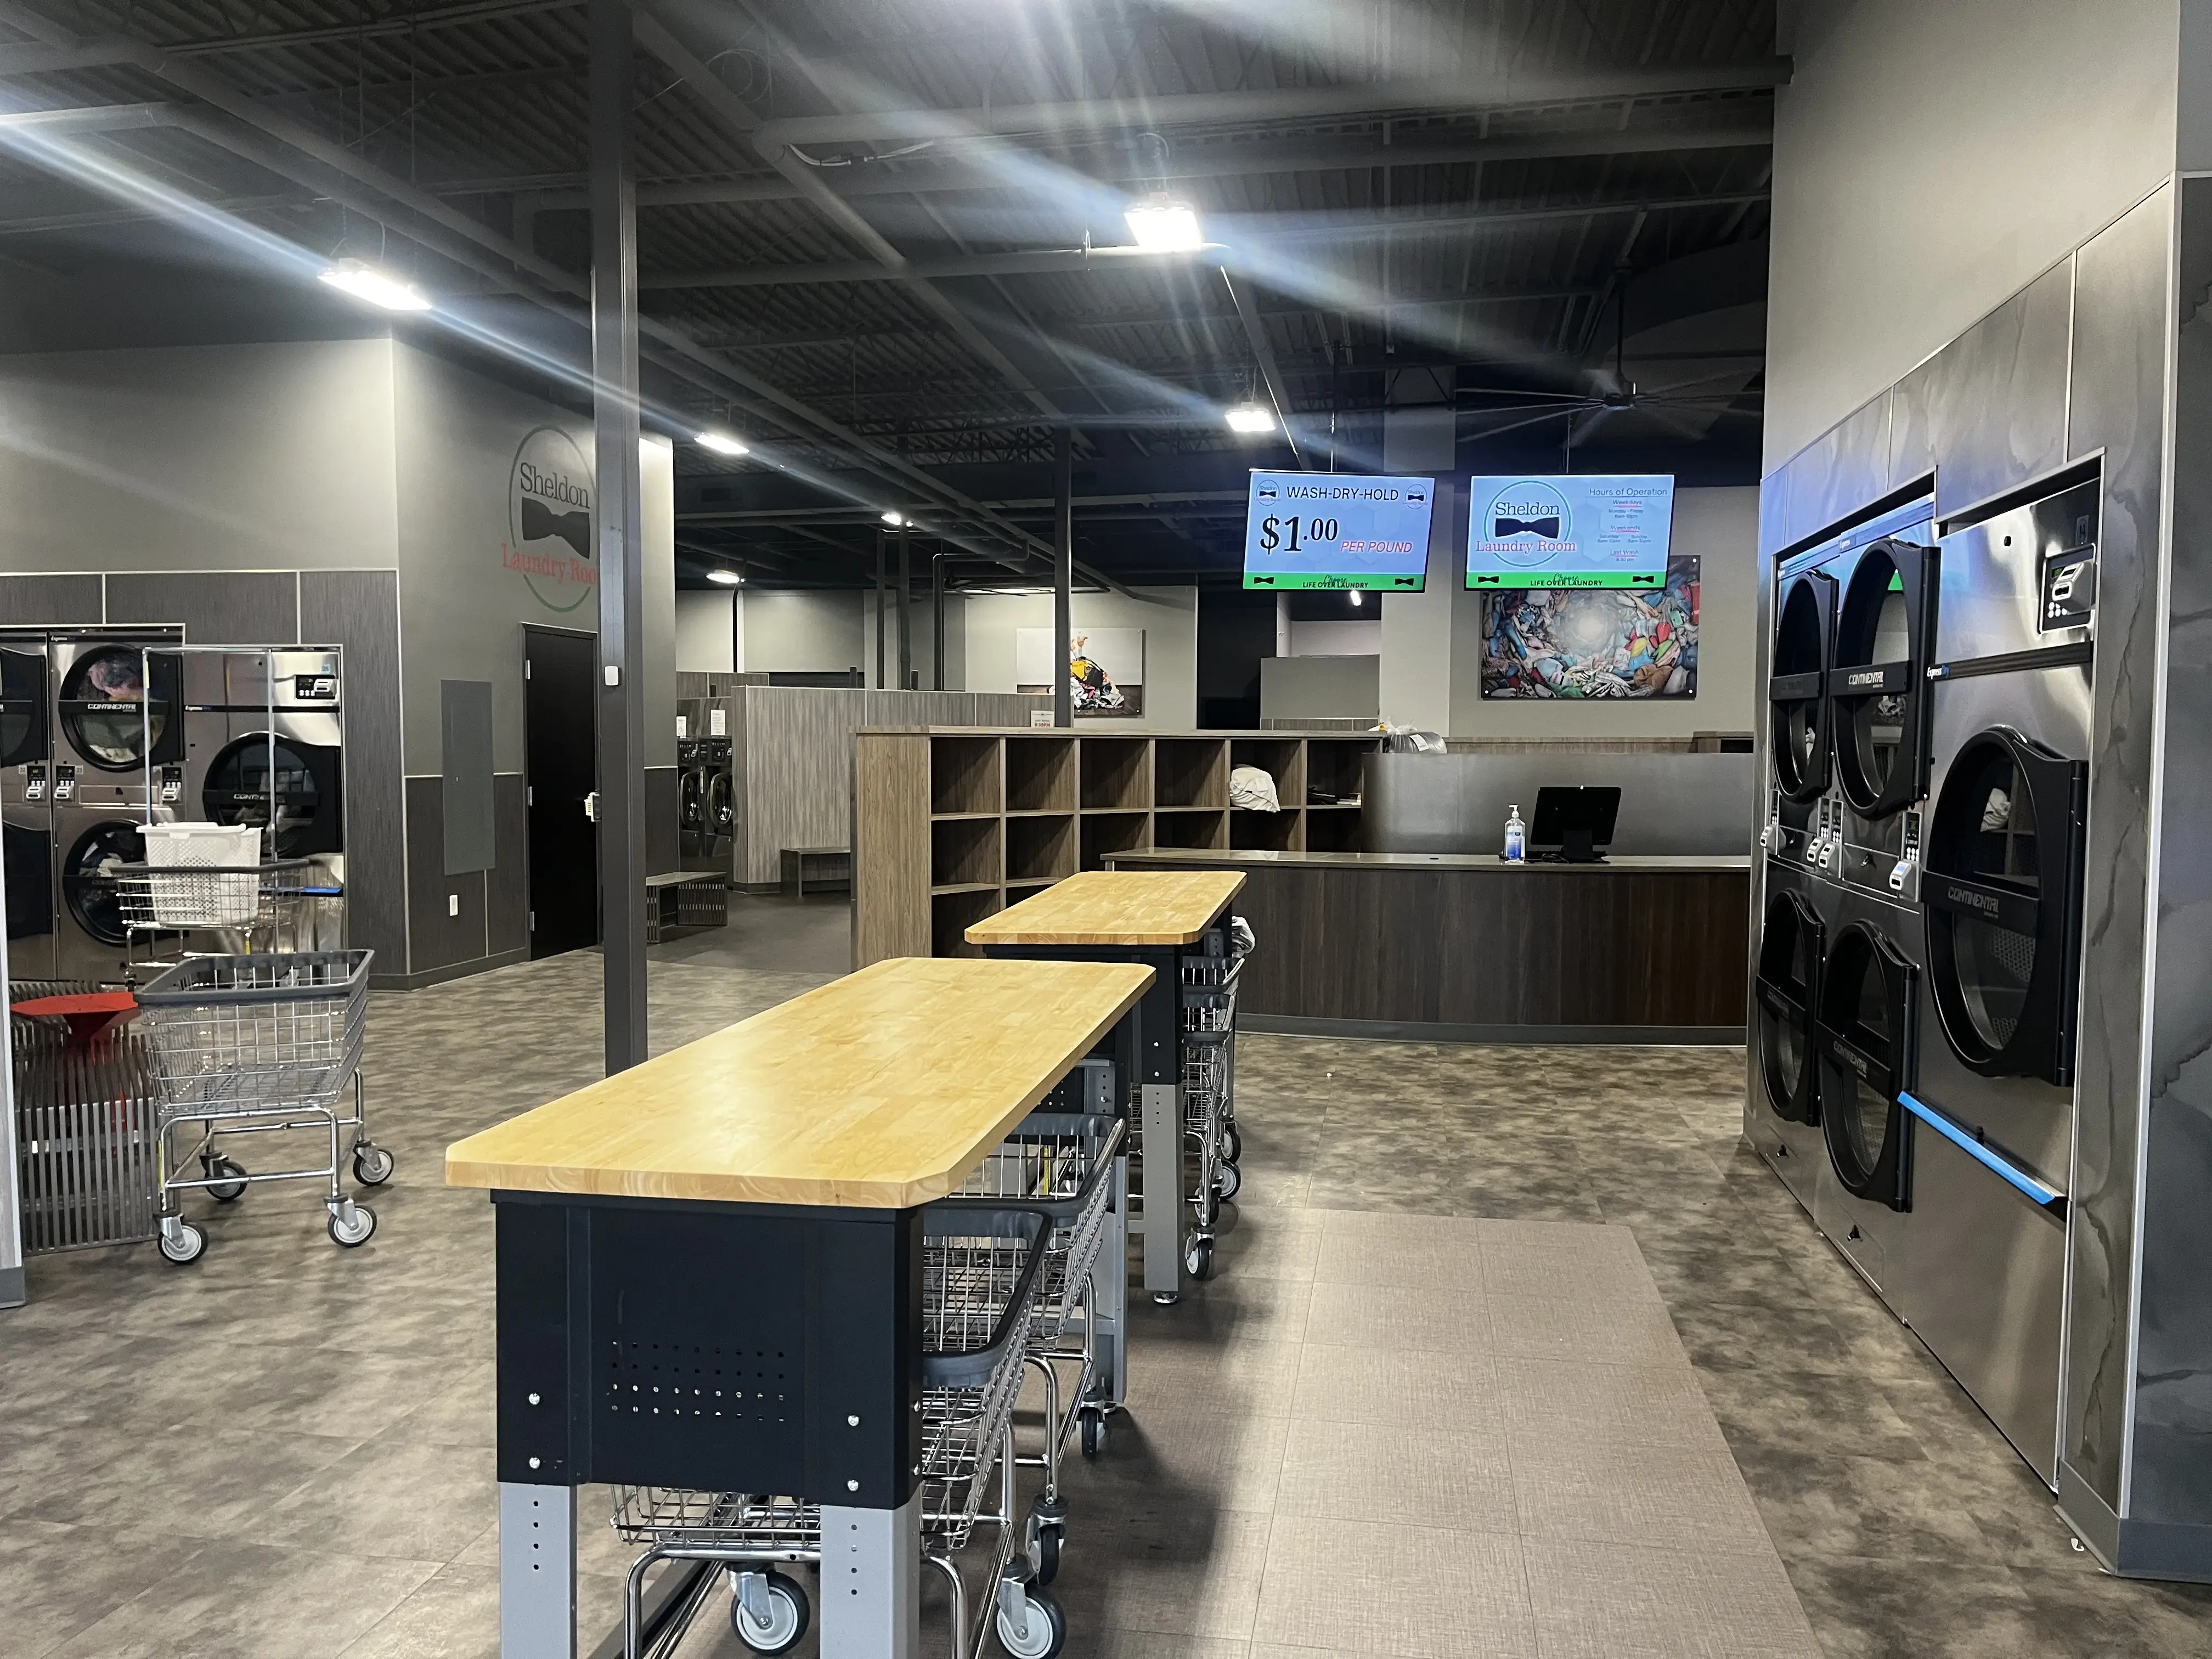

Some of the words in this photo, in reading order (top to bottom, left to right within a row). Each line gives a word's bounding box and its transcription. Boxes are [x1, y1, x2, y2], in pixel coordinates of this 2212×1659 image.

[520, 462, 590, 509] Sheldon
[1626, 488, 1667, 497] Operation
[1287, 486, 1398, 500] WASH-DRY-HOLD
[1495, 502, 1560, 516] Sheldon
[1260, 514, 1338, 555] $1.00
[1340, 541, 1365, 552] PER
[1367, 542, 1412, 552] POUND
[1476, 540, 1533, 554] Laundry
[1537, 540, 1576, 551] Room
[501, 542, 565, 584] Laundry
[569, 557, 598, 584] Roo
[1948, 887, 1999, 913] CONTINENTAL
